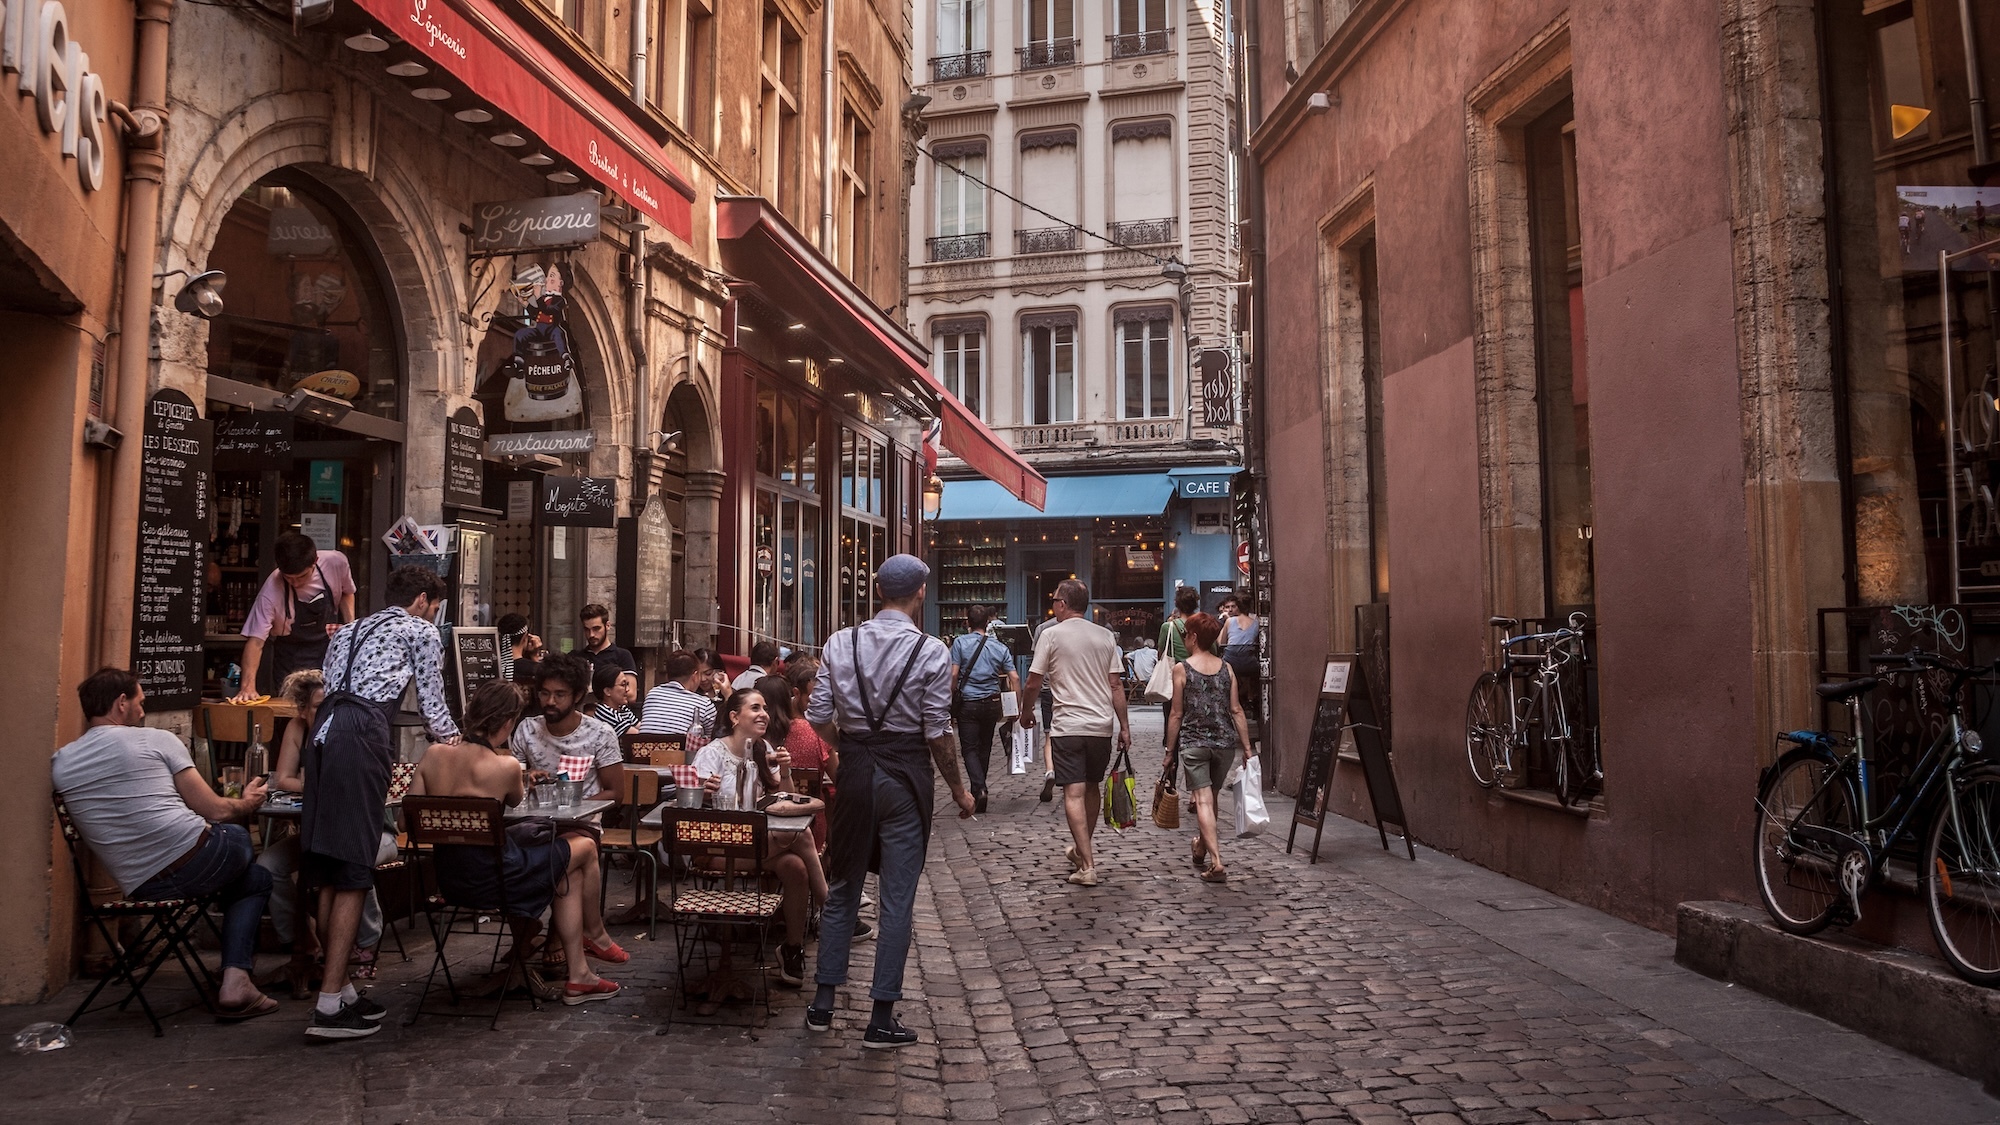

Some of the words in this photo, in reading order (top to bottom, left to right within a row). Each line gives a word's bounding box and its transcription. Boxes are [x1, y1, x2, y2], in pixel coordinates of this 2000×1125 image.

[410, 0, 467, 59] L'épicerie
[588, 140, 618, 180] Bistrot
[622, 172, 628, 188] à
[632, 178, 658, 210] tartines
[478, 205, 596, 246] L'épicerie
[144, 435, 160, 449] LES
[163, 436, 200, 455] DESSERTS
[492, 432, 593, 452] restaurant
[592, 485, 608, 497] 5€
[1186, 482, 1219, 494] CAFE
[545, 486, 588, 518] Mojito
[136, 660, 152, 674] LES
